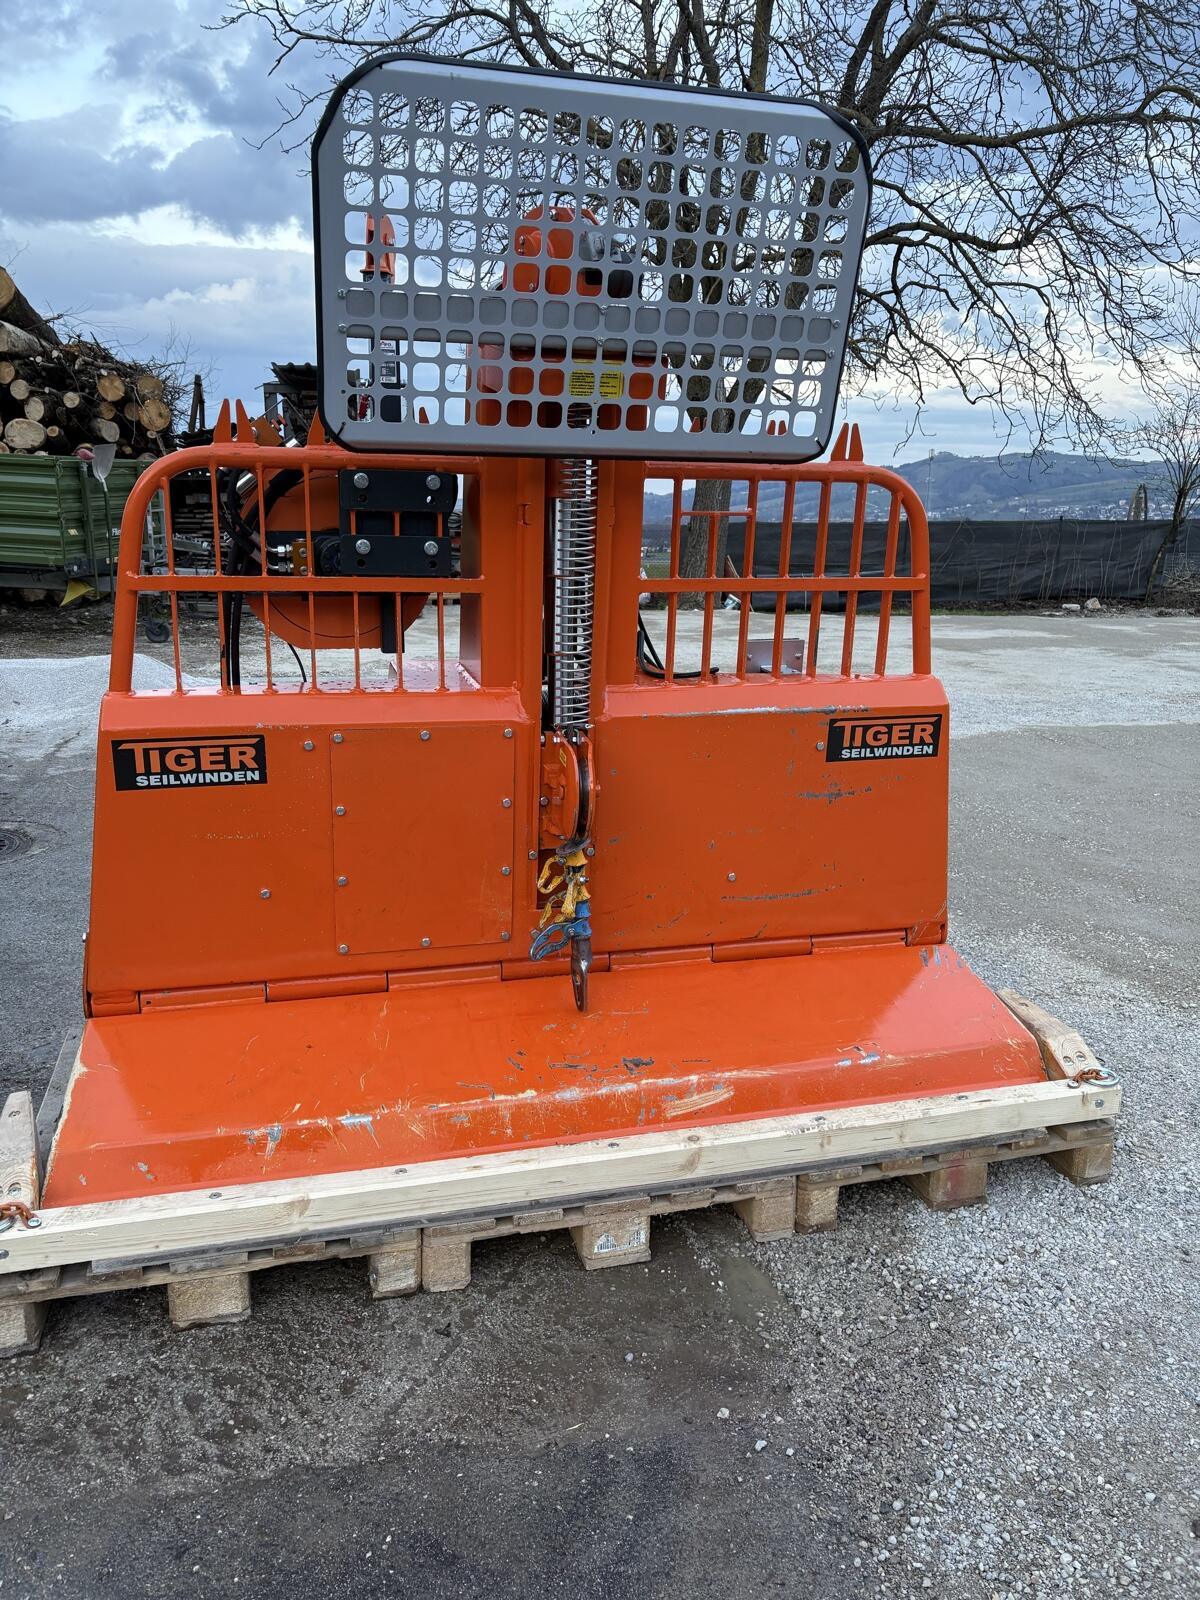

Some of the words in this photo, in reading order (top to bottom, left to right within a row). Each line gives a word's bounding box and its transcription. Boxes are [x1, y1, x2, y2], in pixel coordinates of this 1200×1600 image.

[832, 716, 940, 748] TIGER
[117, 737, 261, 774] TIGER
[841, 745, 933, 759] SEILWINDEN
[135, 770, 260, 787] SEILWINDEN
